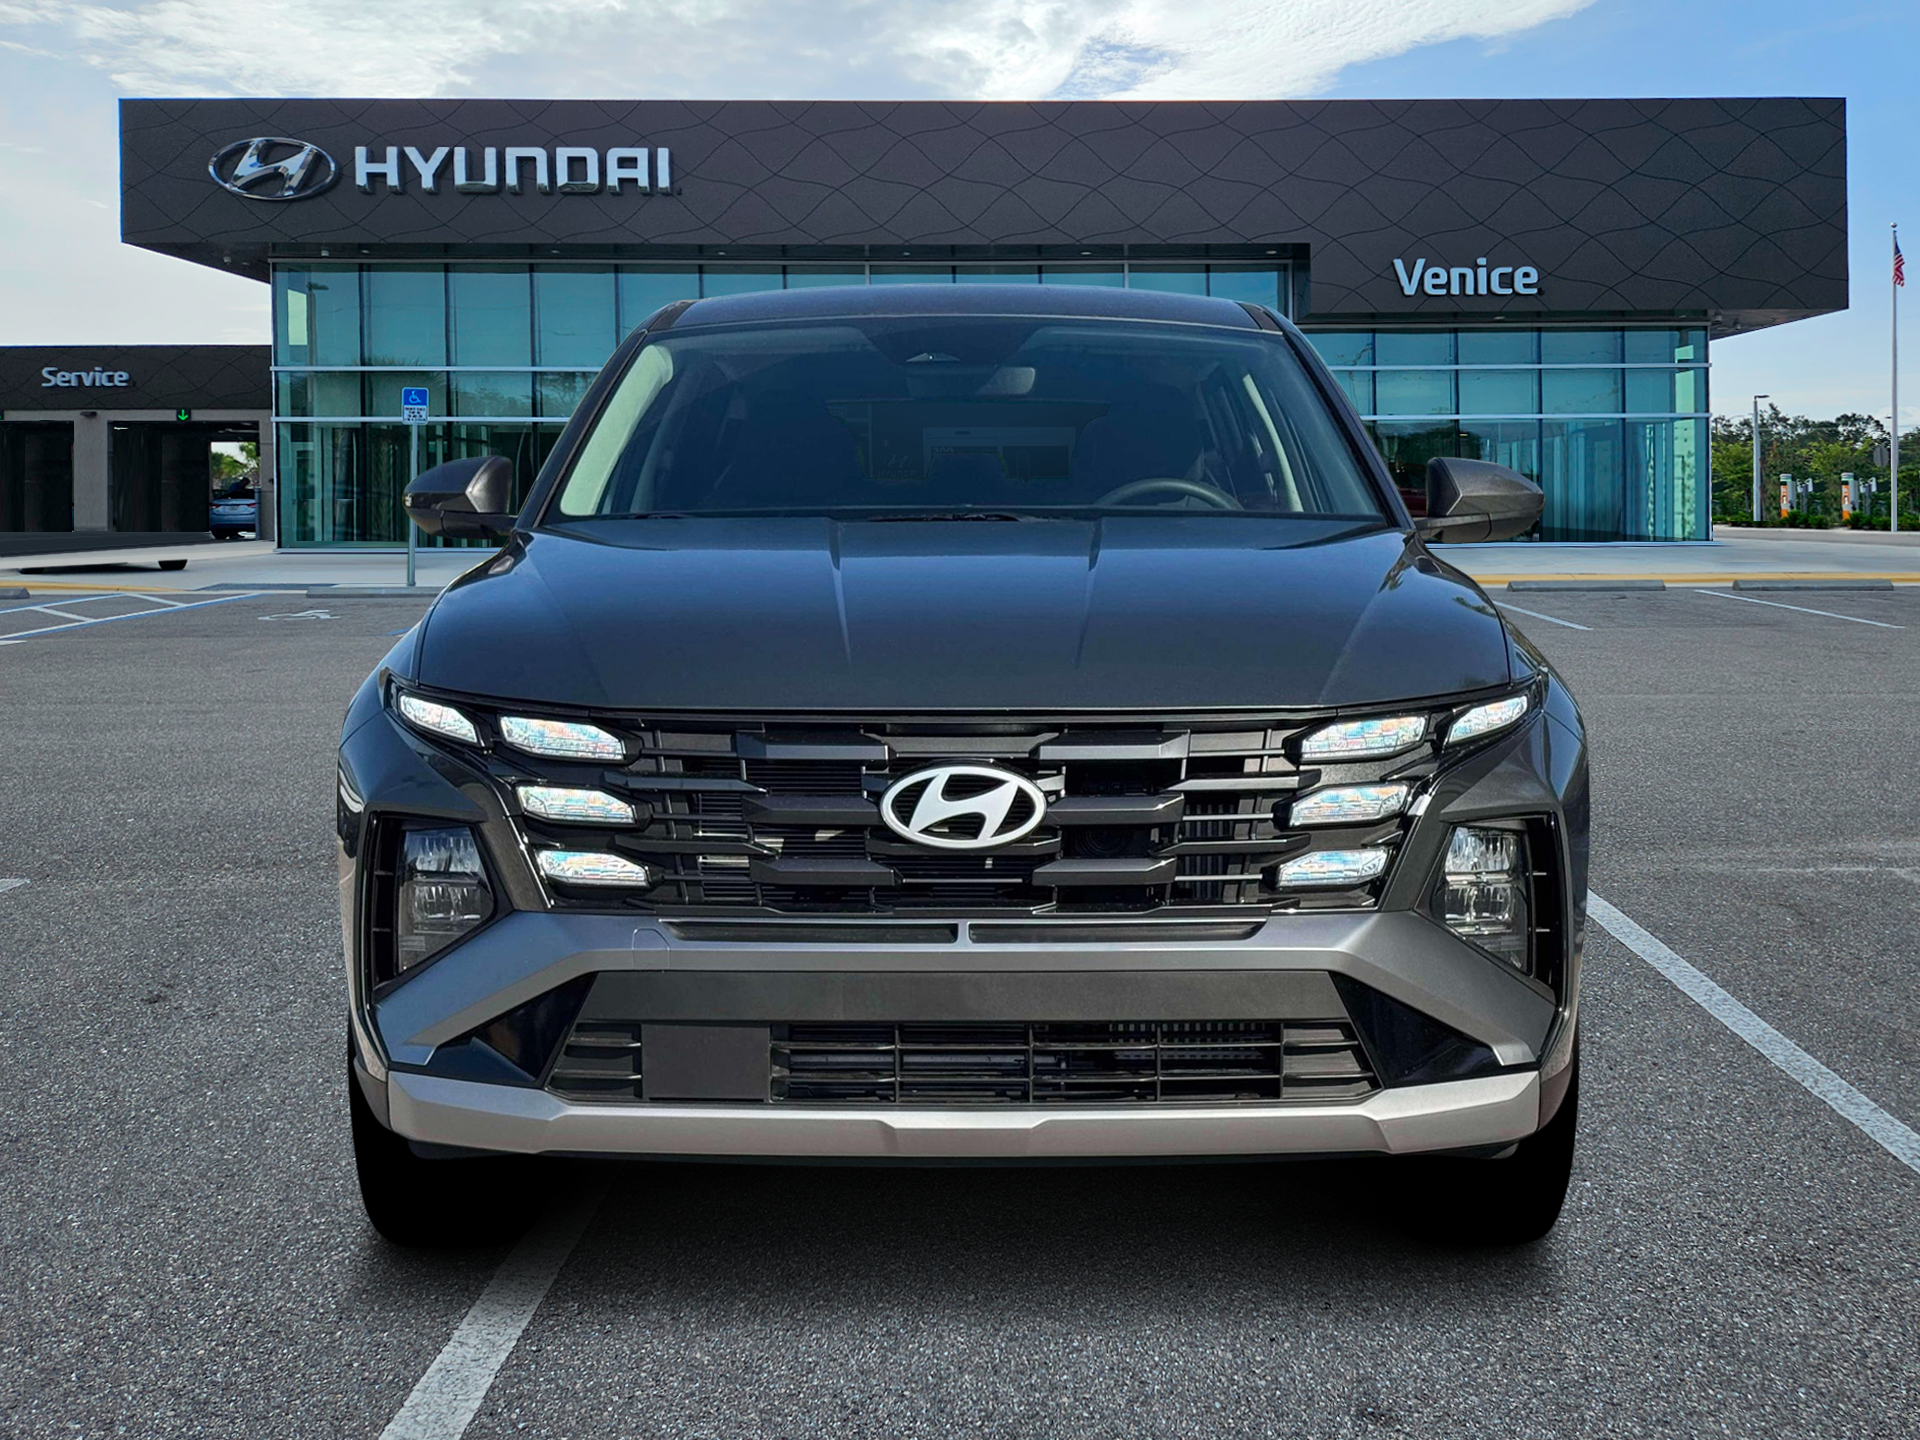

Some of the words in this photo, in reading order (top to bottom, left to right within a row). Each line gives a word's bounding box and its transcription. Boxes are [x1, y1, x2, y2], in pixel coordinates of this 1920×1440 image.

[354, 146, 671, 193] HYUNDAI
[1392, 257, 1539, 296] Venice
[41, 366, 130, 387] Service
